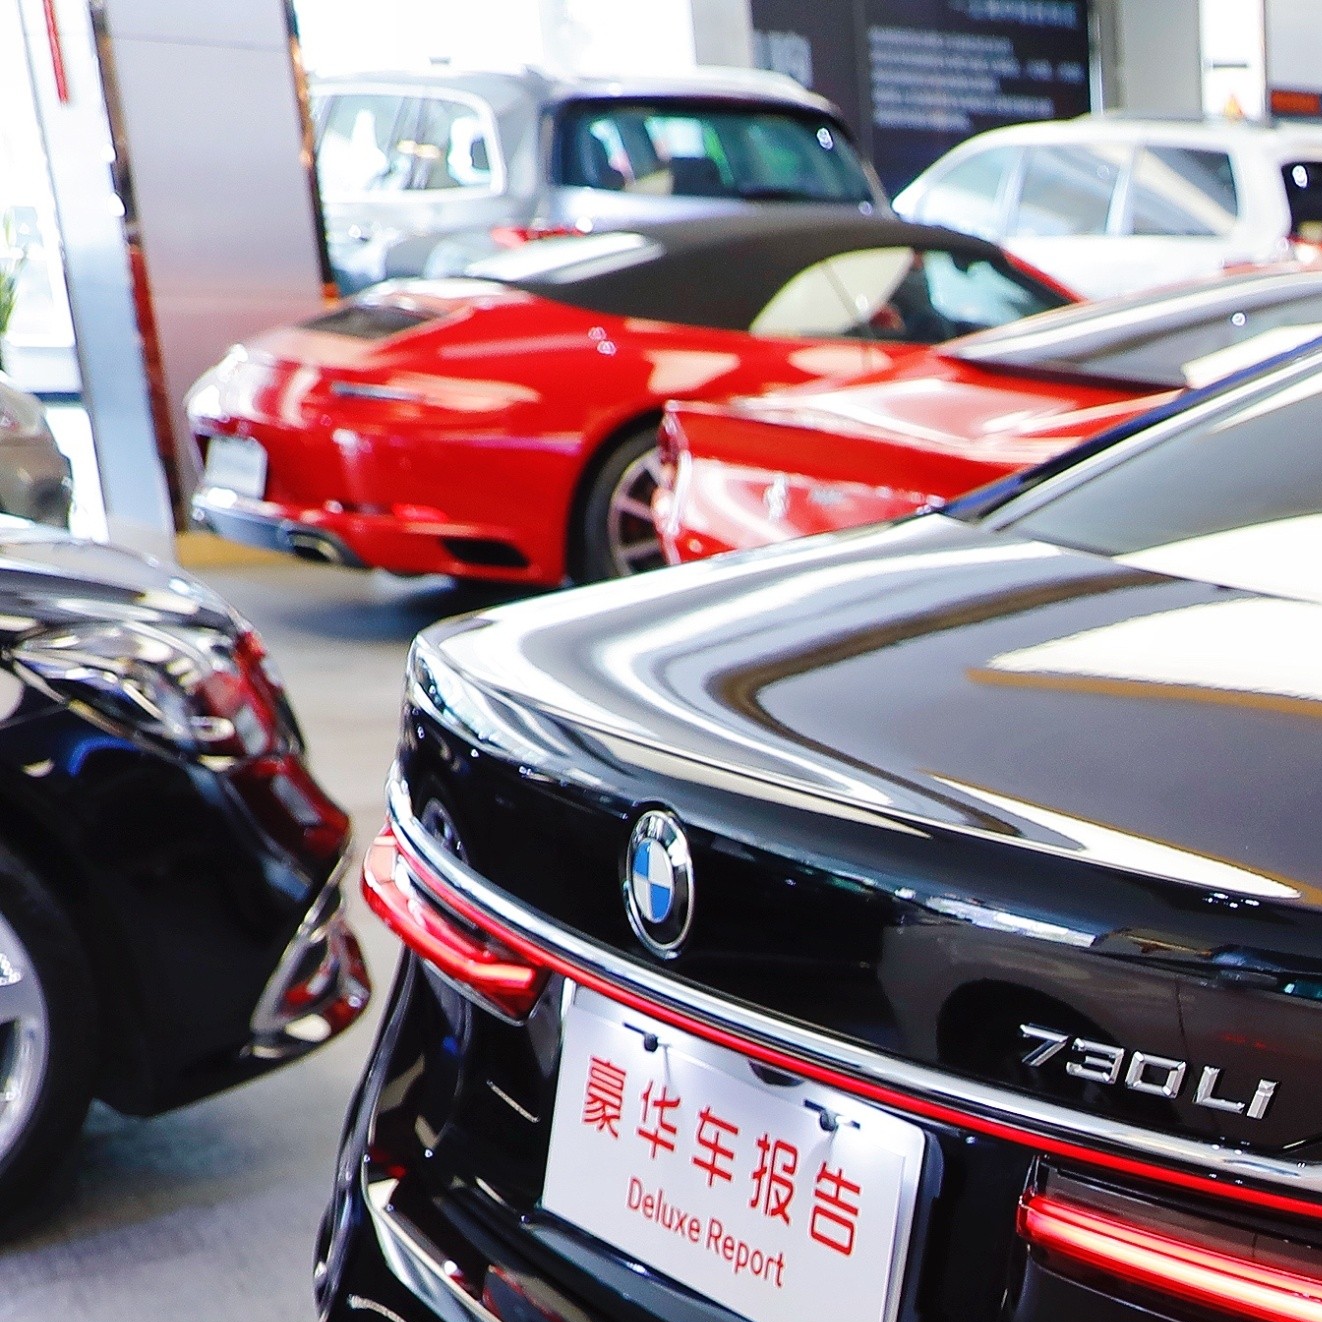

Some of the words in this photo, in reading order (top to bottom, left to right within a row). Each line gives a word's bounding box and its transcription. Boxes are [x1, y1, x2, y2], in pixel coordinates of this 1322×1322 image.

[582, 1054, 862, 1258] 豪华车报告
[626, 1176, 702, 1244] Deluxe
[704, 1217, 786, 1288] Report
